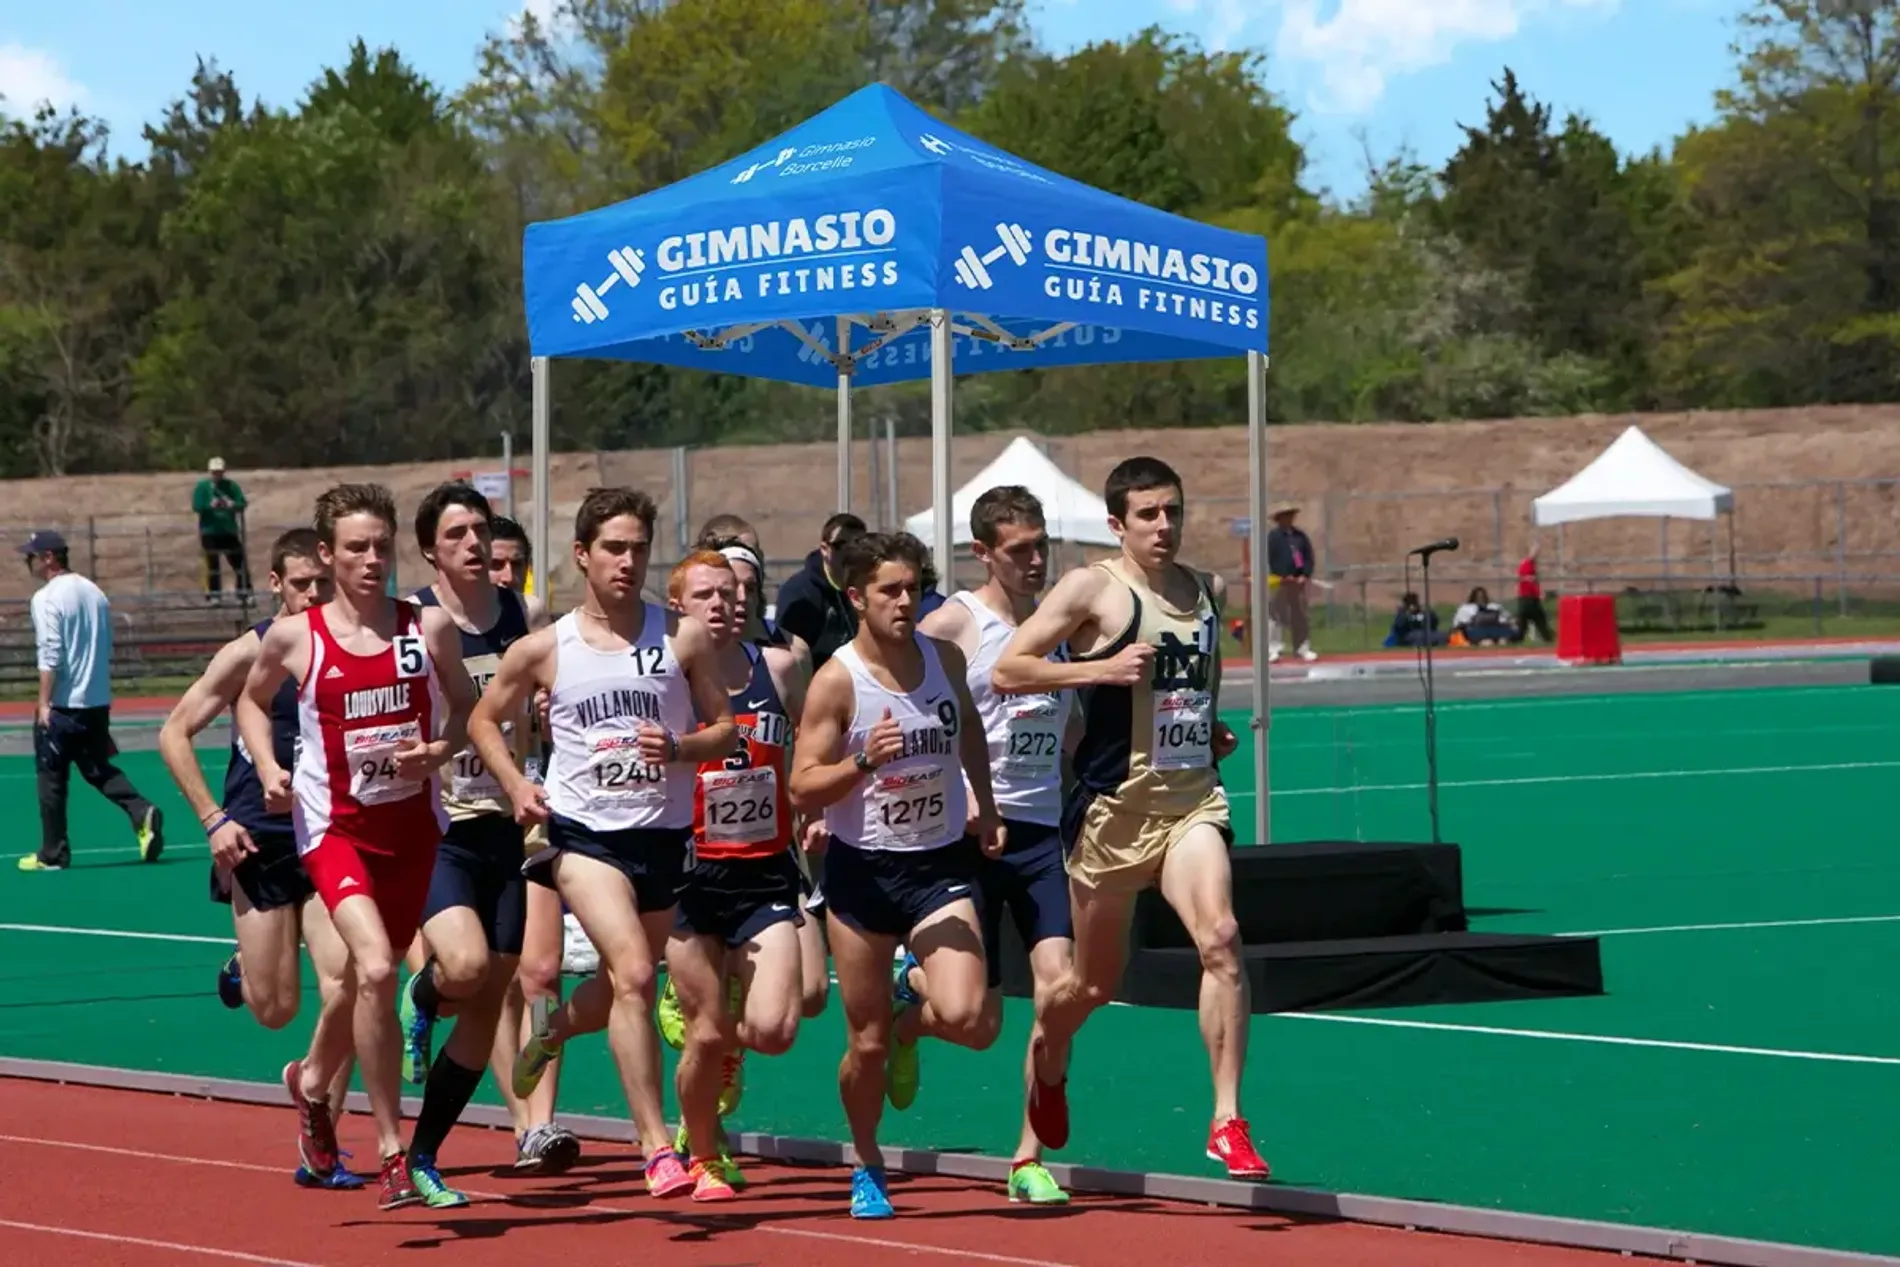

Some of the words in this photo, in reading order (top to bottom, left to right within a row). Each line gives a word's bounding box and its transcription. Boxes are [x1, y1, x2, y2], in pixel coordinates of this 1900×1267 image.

[799, 135, 877, 158] Gimnasio
[656, 208, 896, 272] GIMNASIO
[1044, 228, 1258, 294] GIMNASIO
[659, 275, 743, 310] GUÍA
[759, 261, 898, 297] FITNESS
[1044, 276, 1123, 305] GUÍA
[1138, 288, 1259, 329] FITNESS
[400, 638, 423, 674] 5
[630, 646, 666, 676] 12
[344, 682, 410, 719] LOUISVILLE
[576, 690, 661, 728] VILLANOVA
[938, 700, 958, 737] 9
[1159, 722, 1209, 748] 1043
[1009, 732, 1057, 757] 1272
[361, 757, 397, 783] 94
[594, 762, 661, 786] 1240
[708, 796, 773, 825] 1226
[881, 792, 943, 826] 1275
